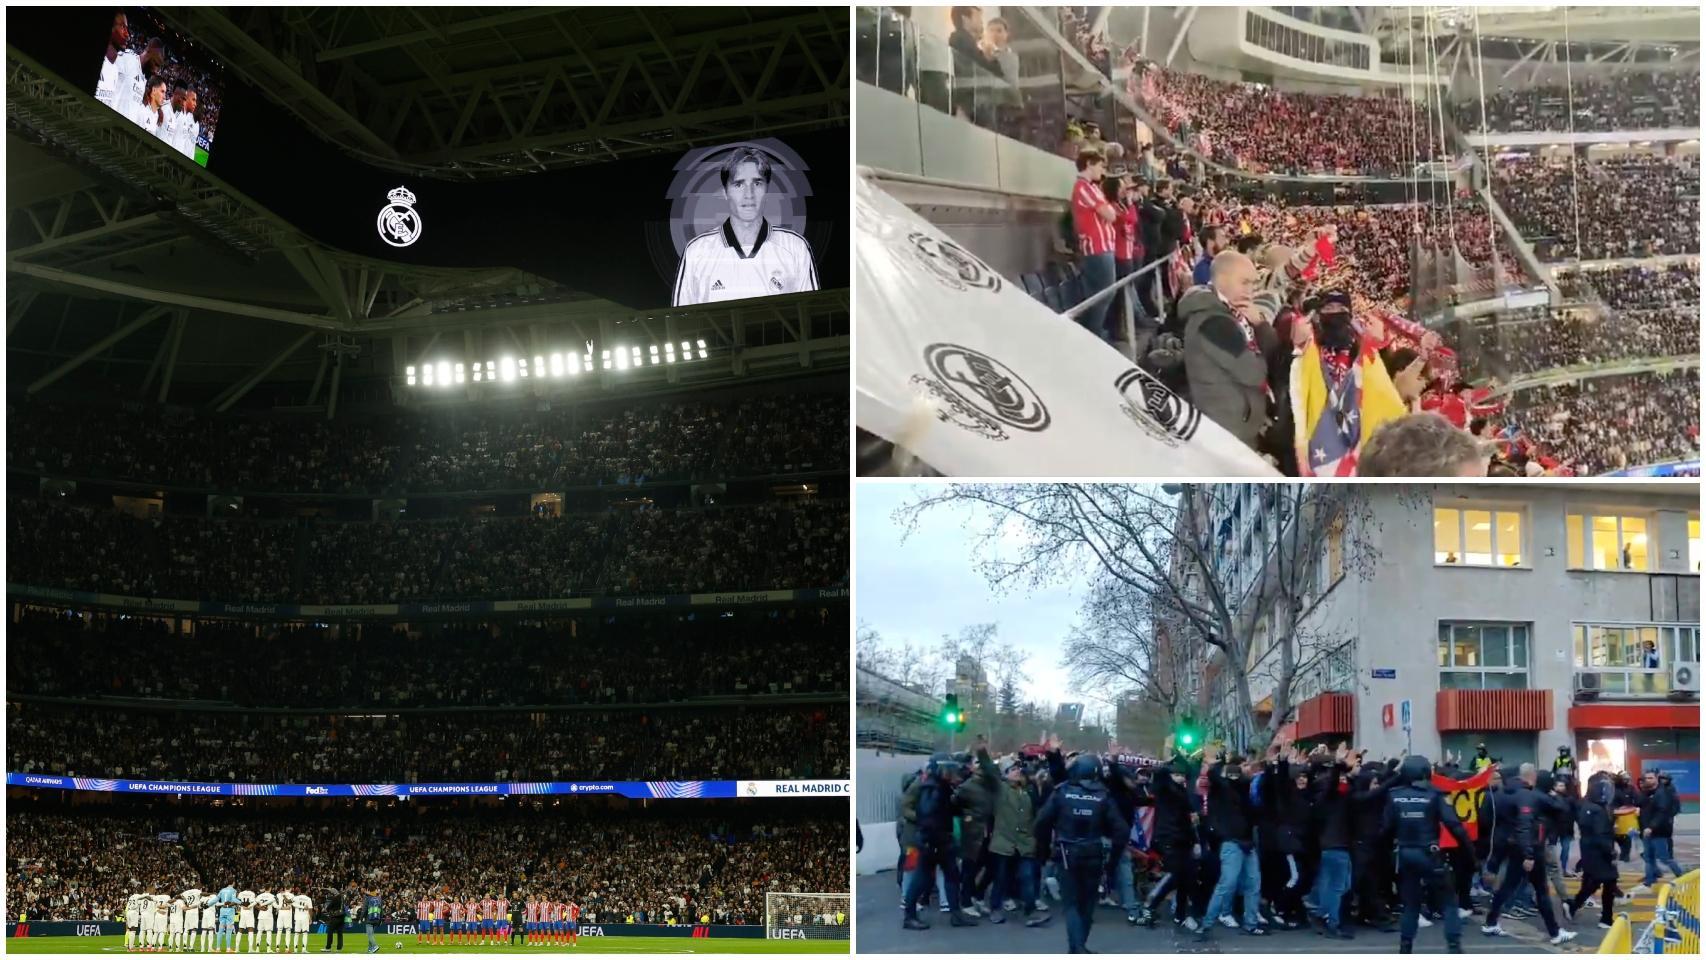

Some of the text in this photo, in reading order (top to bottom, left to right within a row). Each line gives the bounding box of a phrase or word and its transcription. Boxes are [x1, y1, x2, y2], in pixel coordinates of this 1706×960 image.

[820, 589, 838, 598] Real
[616, 597, 666, 607] Real Madrid
[716, 594, 768, 604] Real Madrid
[224, 604, 276, 614] Real Madrid
[422, 603, 471, 613] Real Madrid
[129, 783, 221, 793] UEFA CHAMPIONS LEAGUE
[305, 786, 329, 795] FedEx
[578, 784, 614, 792] crypto.com
[775, 784, 800, 793] REAL
[802, 783, 841, 793] MADRID
[76, 924, 101, 936] UEFA
[387, 924, 416, 935] UEFA
[772, 928, 806, 940] UEFA
